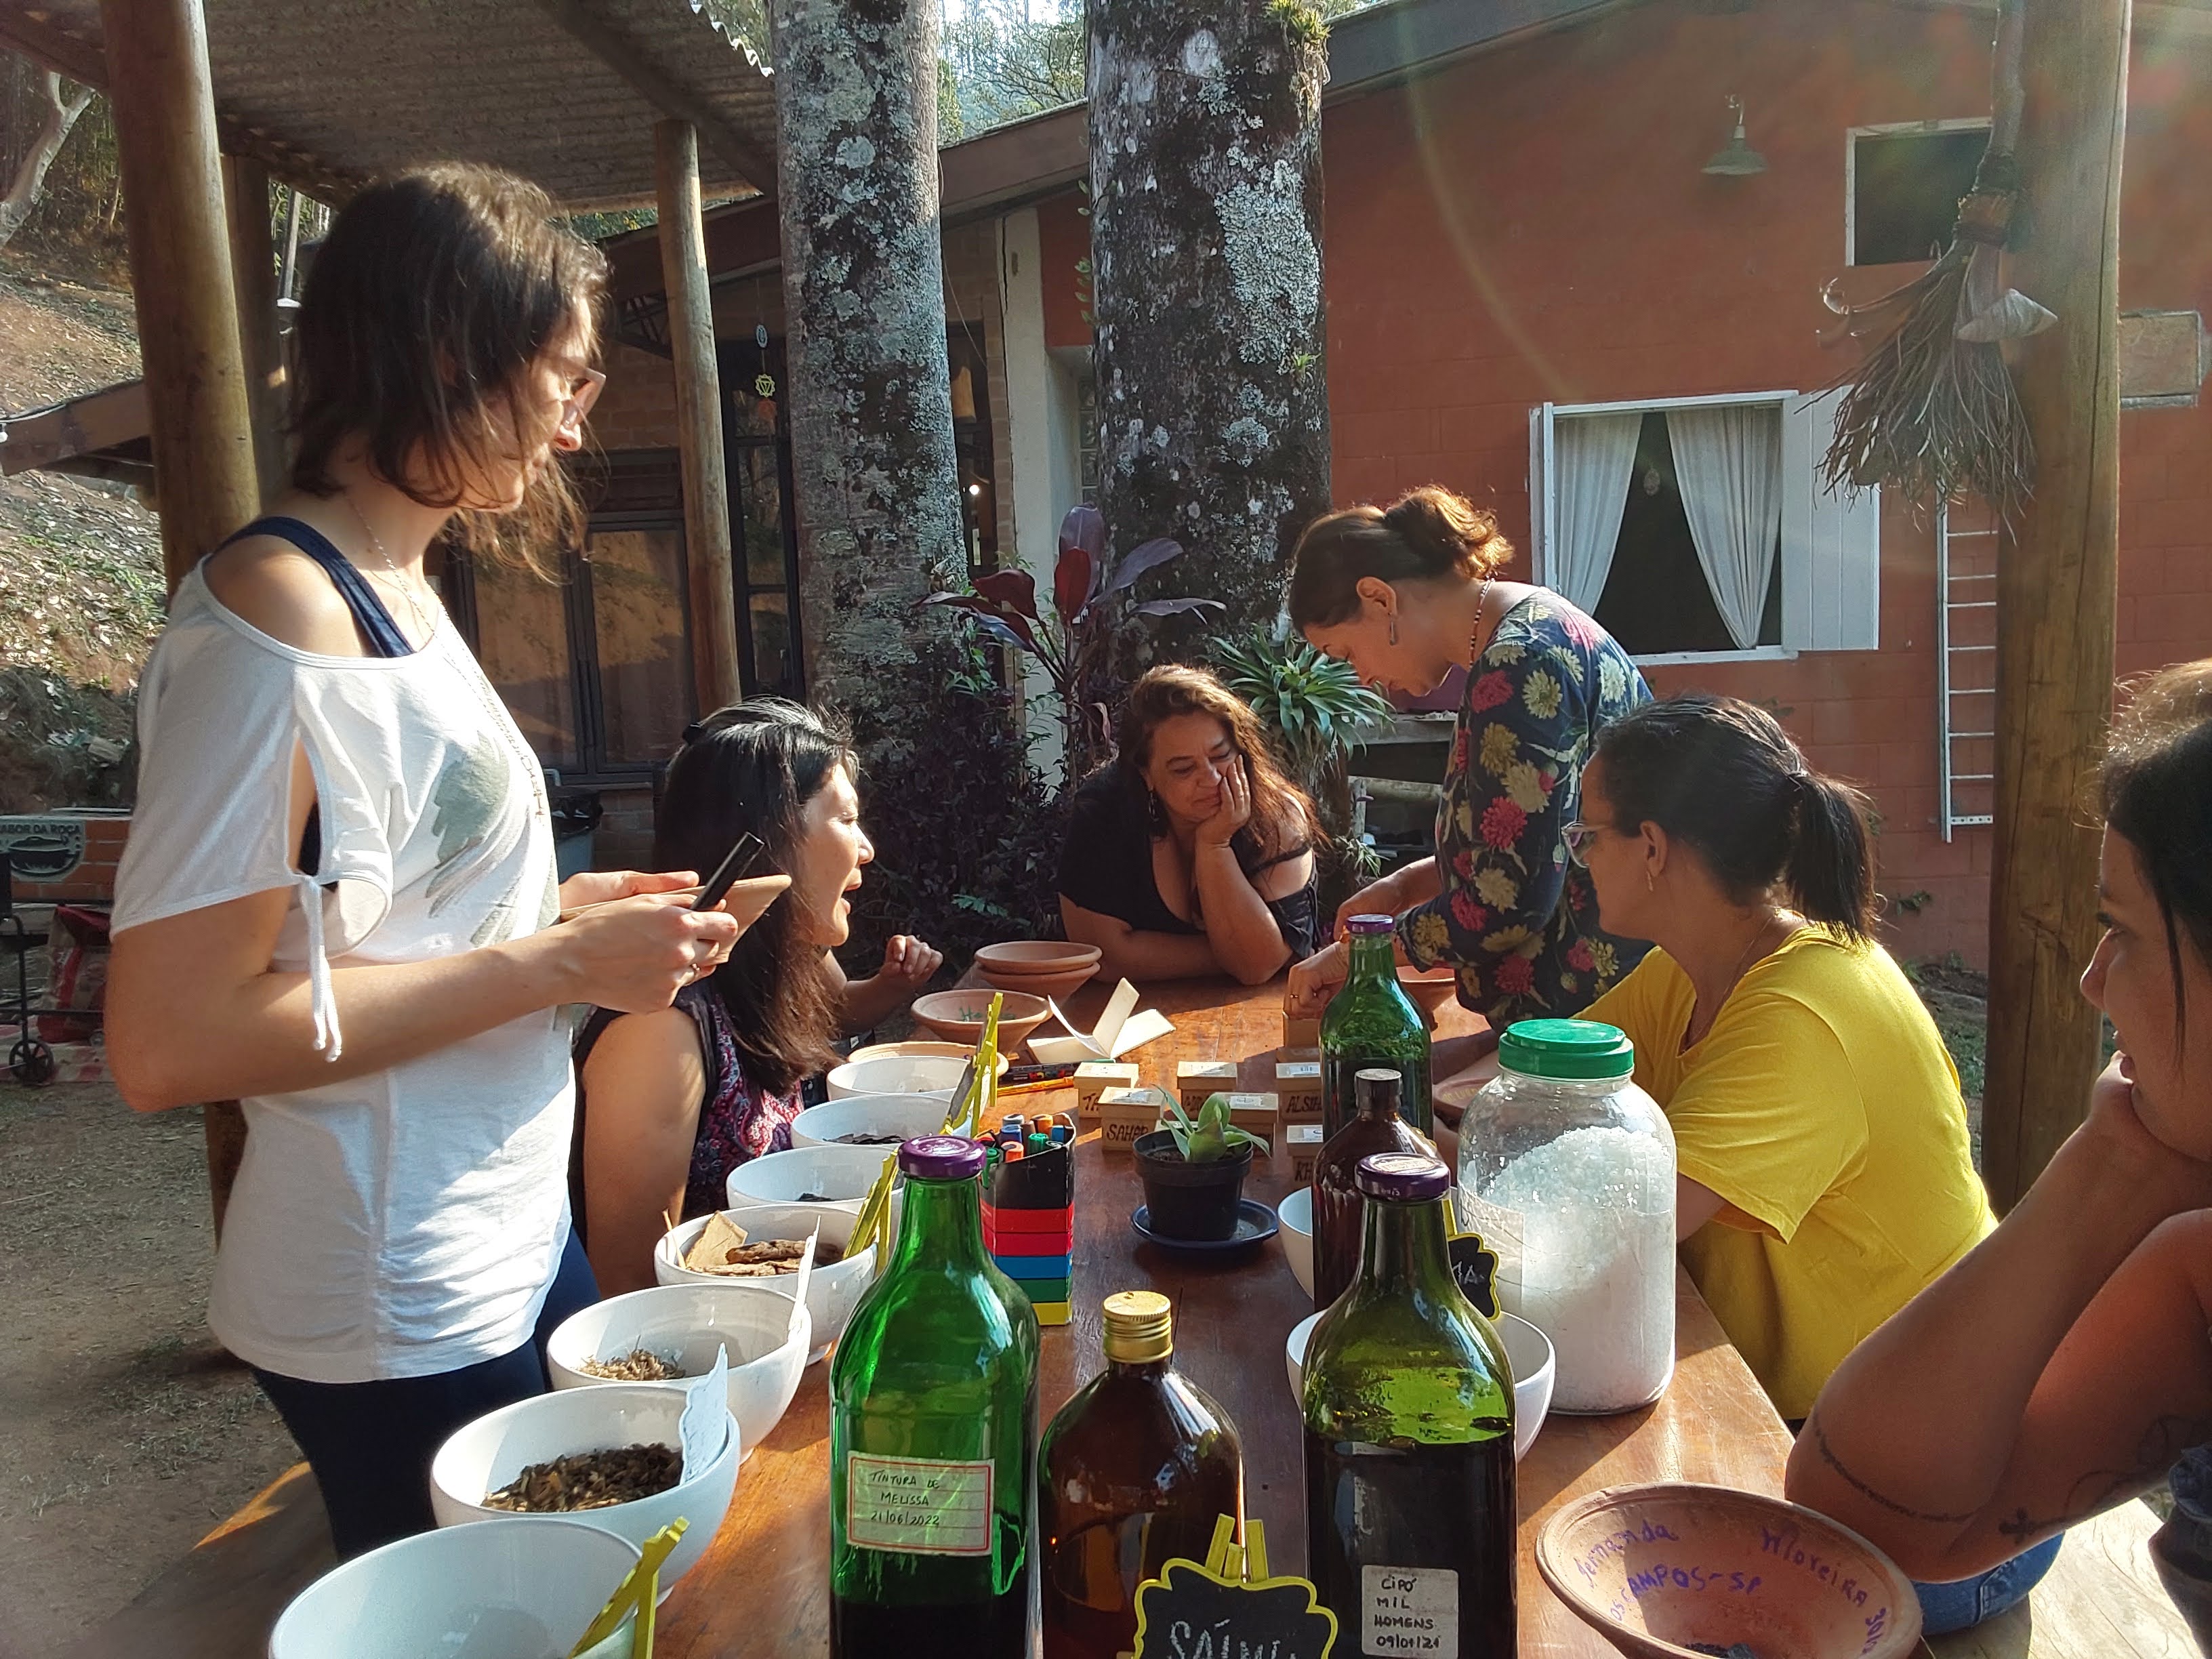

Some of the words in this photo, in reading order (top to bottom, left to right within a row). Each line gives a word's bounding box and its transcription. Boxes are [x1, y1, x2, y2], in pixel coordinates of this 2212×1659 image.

[0, 824, 30, 834] ABOR
[926, 1479, 941, 1489] DE
[870, 1509, 940, 1525] 21/06/2022
[1376, 1596, 1410, 1610] MIL
[1374, 1614, 1435, 1630] HOMENS
